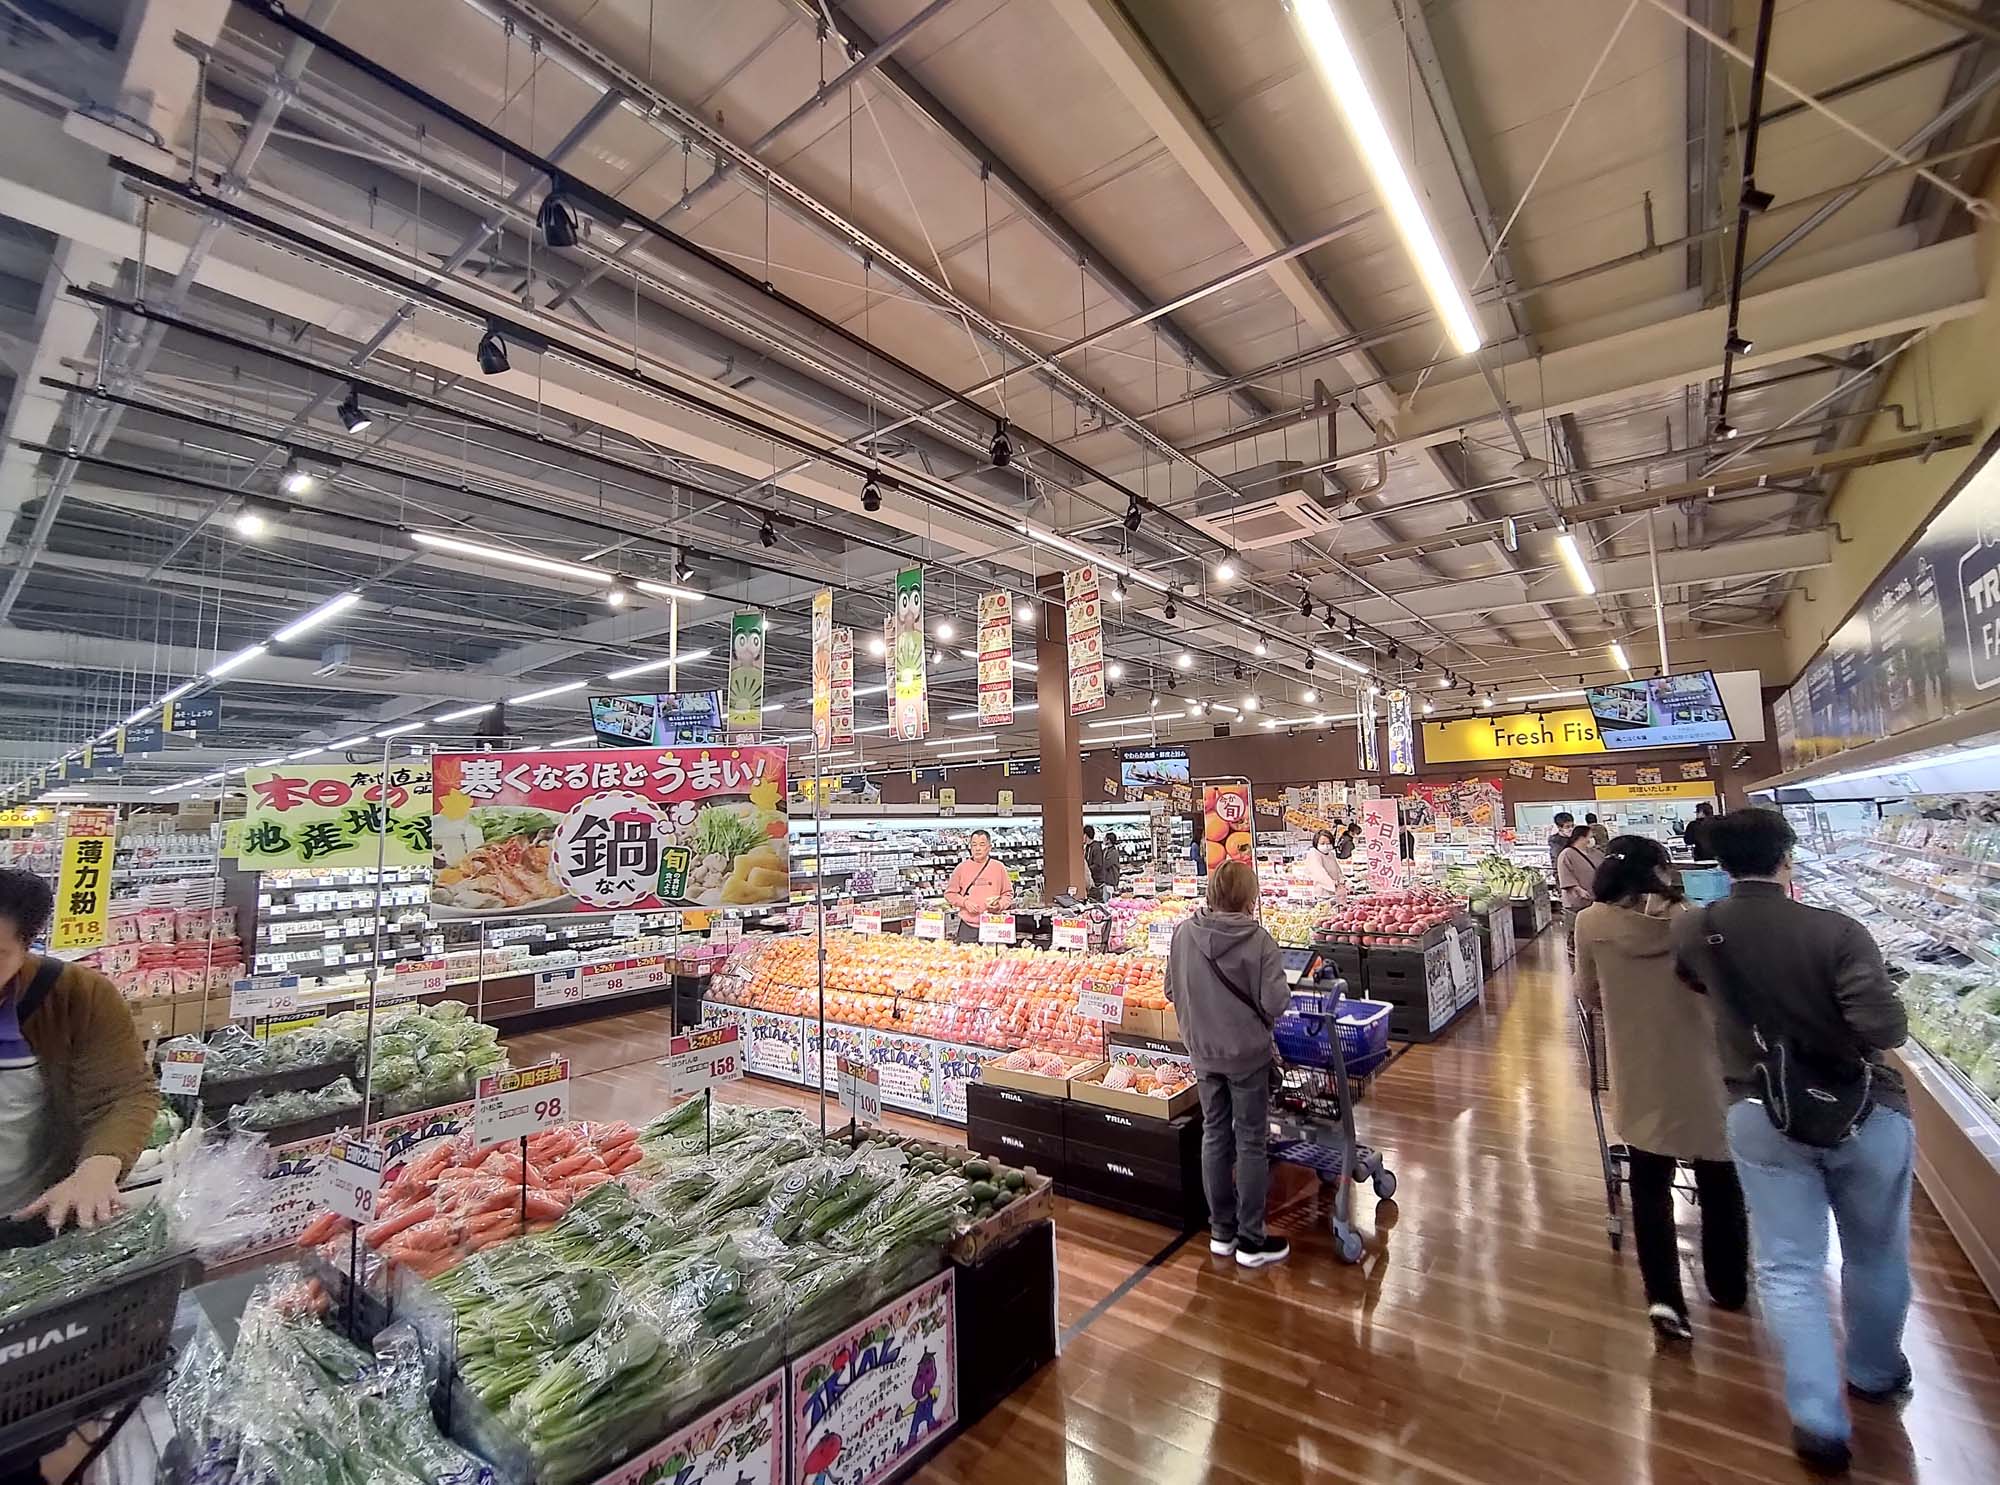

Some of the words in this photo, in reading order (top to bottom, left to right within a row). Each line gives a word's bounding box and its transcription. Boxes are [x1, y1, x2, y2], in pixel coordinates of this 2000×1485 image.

[1969, 565, 2000, 614] TR
[1495, 724, 1553, 746] Fresh
[460, 757, 765, 799] 寒くなるほどうまい!
[252, 773, 409, 812] 本日の
[568, 815, 657, 879] 鍋
[663, 849, 688, 873] 旬
[69, 840, 104, 915] 薄力粉
[596, 879, 635, 894] なべ
[60, 920, 100, 936] 118
[74, 937, 94, 945] 127
[423, 977, 441, 989] 138
[607, 978, 623, 990] 98
[649, 971, 663, 982] 98
[564, 986, 579, 998] 98
[752, 1025, 790, 1044] TRIAL
[1146, 1042, 1171, 1051] TRIAL
[710, 1056, 735, 1078] 158
[870, 1047, 920, 1070] TRIAL
[521, 1065, 562, 1087] 周年祭
[941, 1062, 982, 1080] TRIA
[860, 1094, 877, 1115] 100
[1000, 1092, 1023, 1102] TRIAL
[534, 1097, 561, 1121] 98
[1105, 1114, 1132, 1126] TRIAL
[385, 1121, 463, 1158] TRIAL
[1001, 1136, 1024, 1148] TRIAL
[1106, 1163, 1133, 1176] TRIAL
[355, 1186, 372, 1211] 98
[802, 1337, 902, 1431] TRIAL
